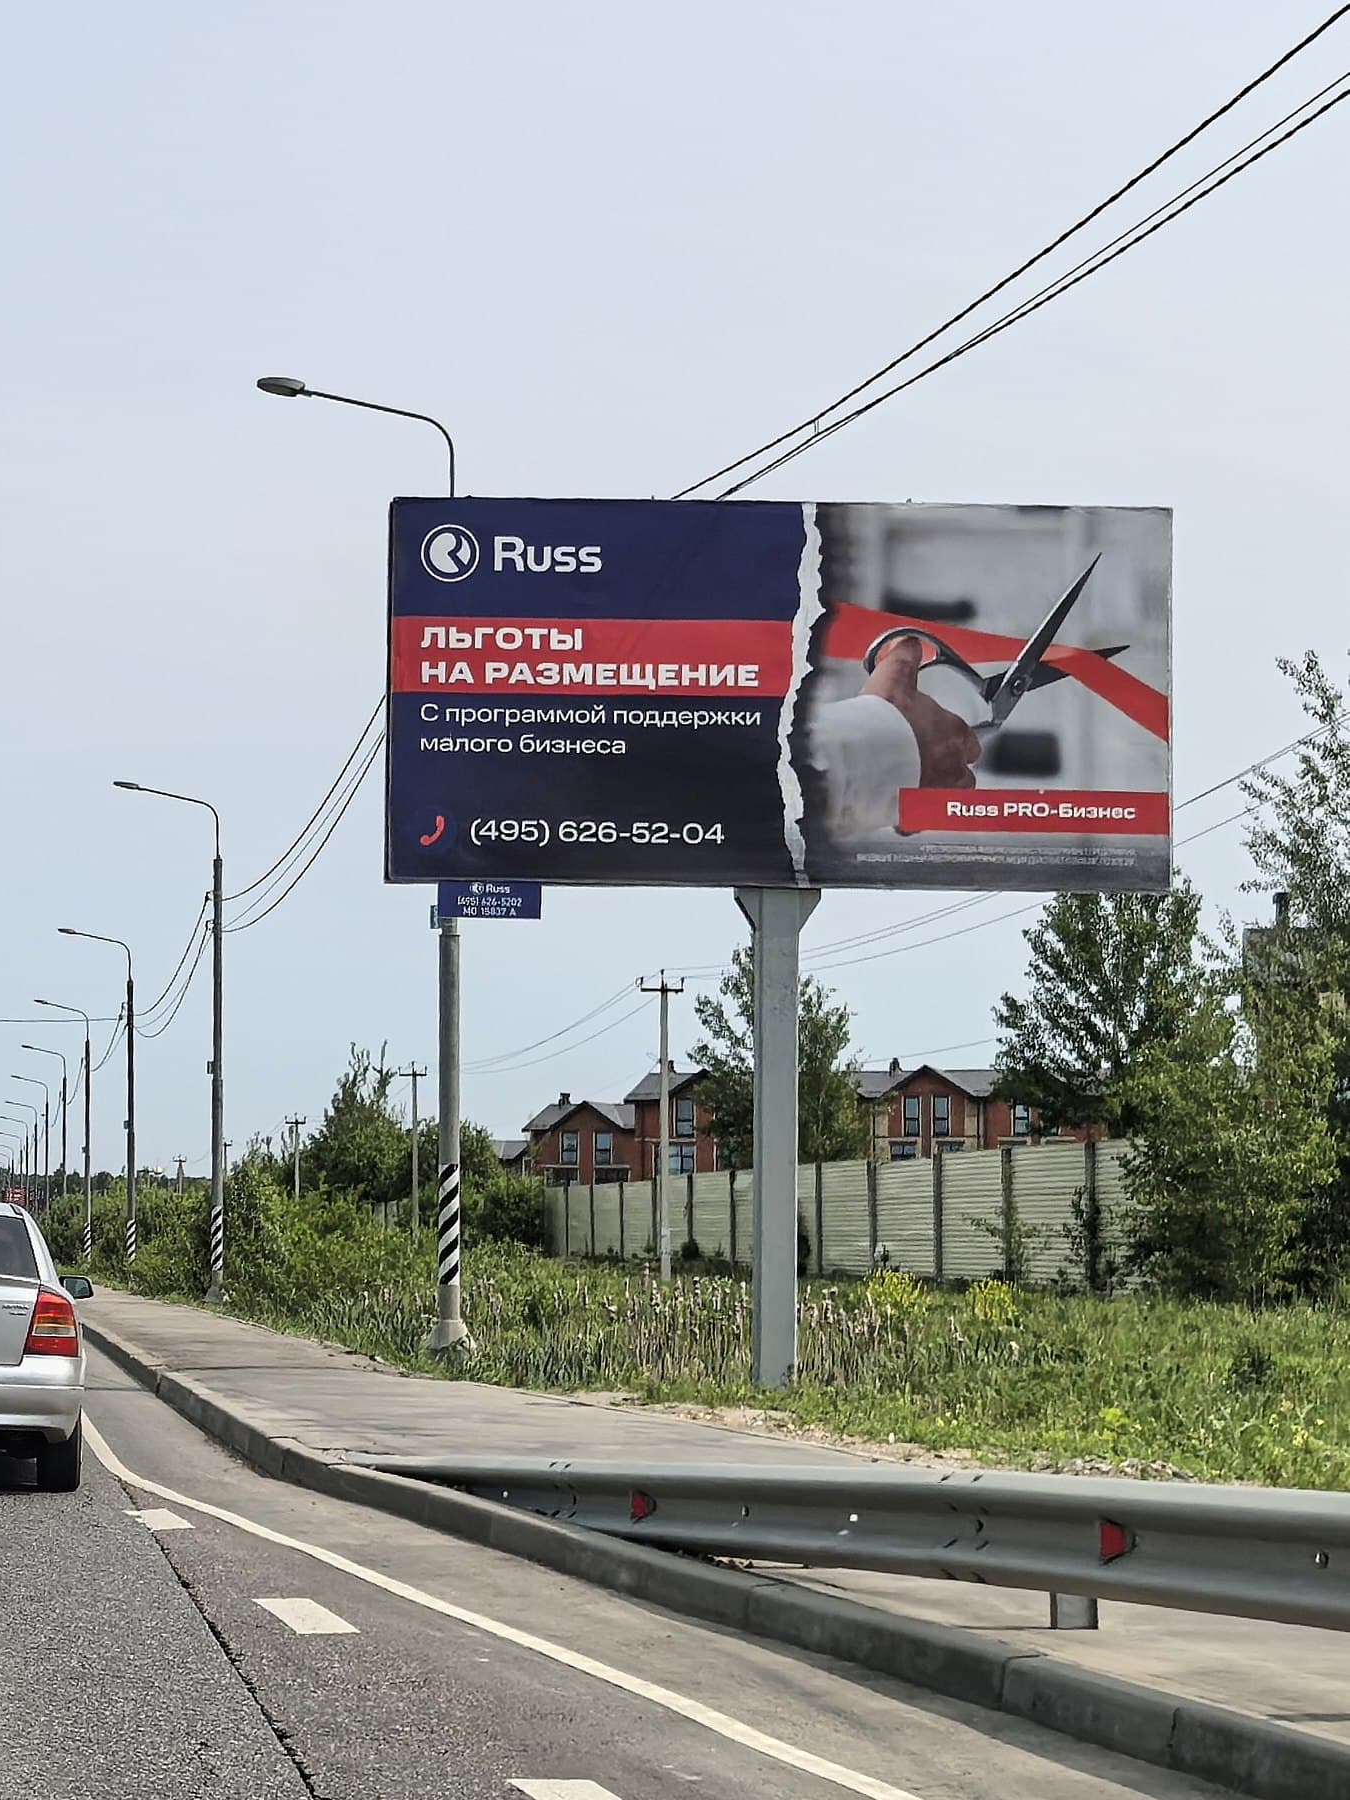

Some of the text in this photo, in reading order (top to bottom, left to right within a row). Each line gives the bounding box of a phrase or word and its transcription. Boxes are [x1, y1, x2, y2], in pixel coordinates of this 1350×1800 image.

[492, 535, 603, 573] Russ
[419, 626, 583, 651] ЛЬГОТЫ
[420, 661, 760, 690] НА РАЗМЕЩЕНИЕ
[419, 703, 761, 729] С программой поддержки
[419, 733, 627, 755] малого бизнеса
[946, 801, 1137, 820] Russ PRO-Бизнес
[469, 818, 725, 847] (495) 626-52-04
[486, 883, 511, 894] Russ
